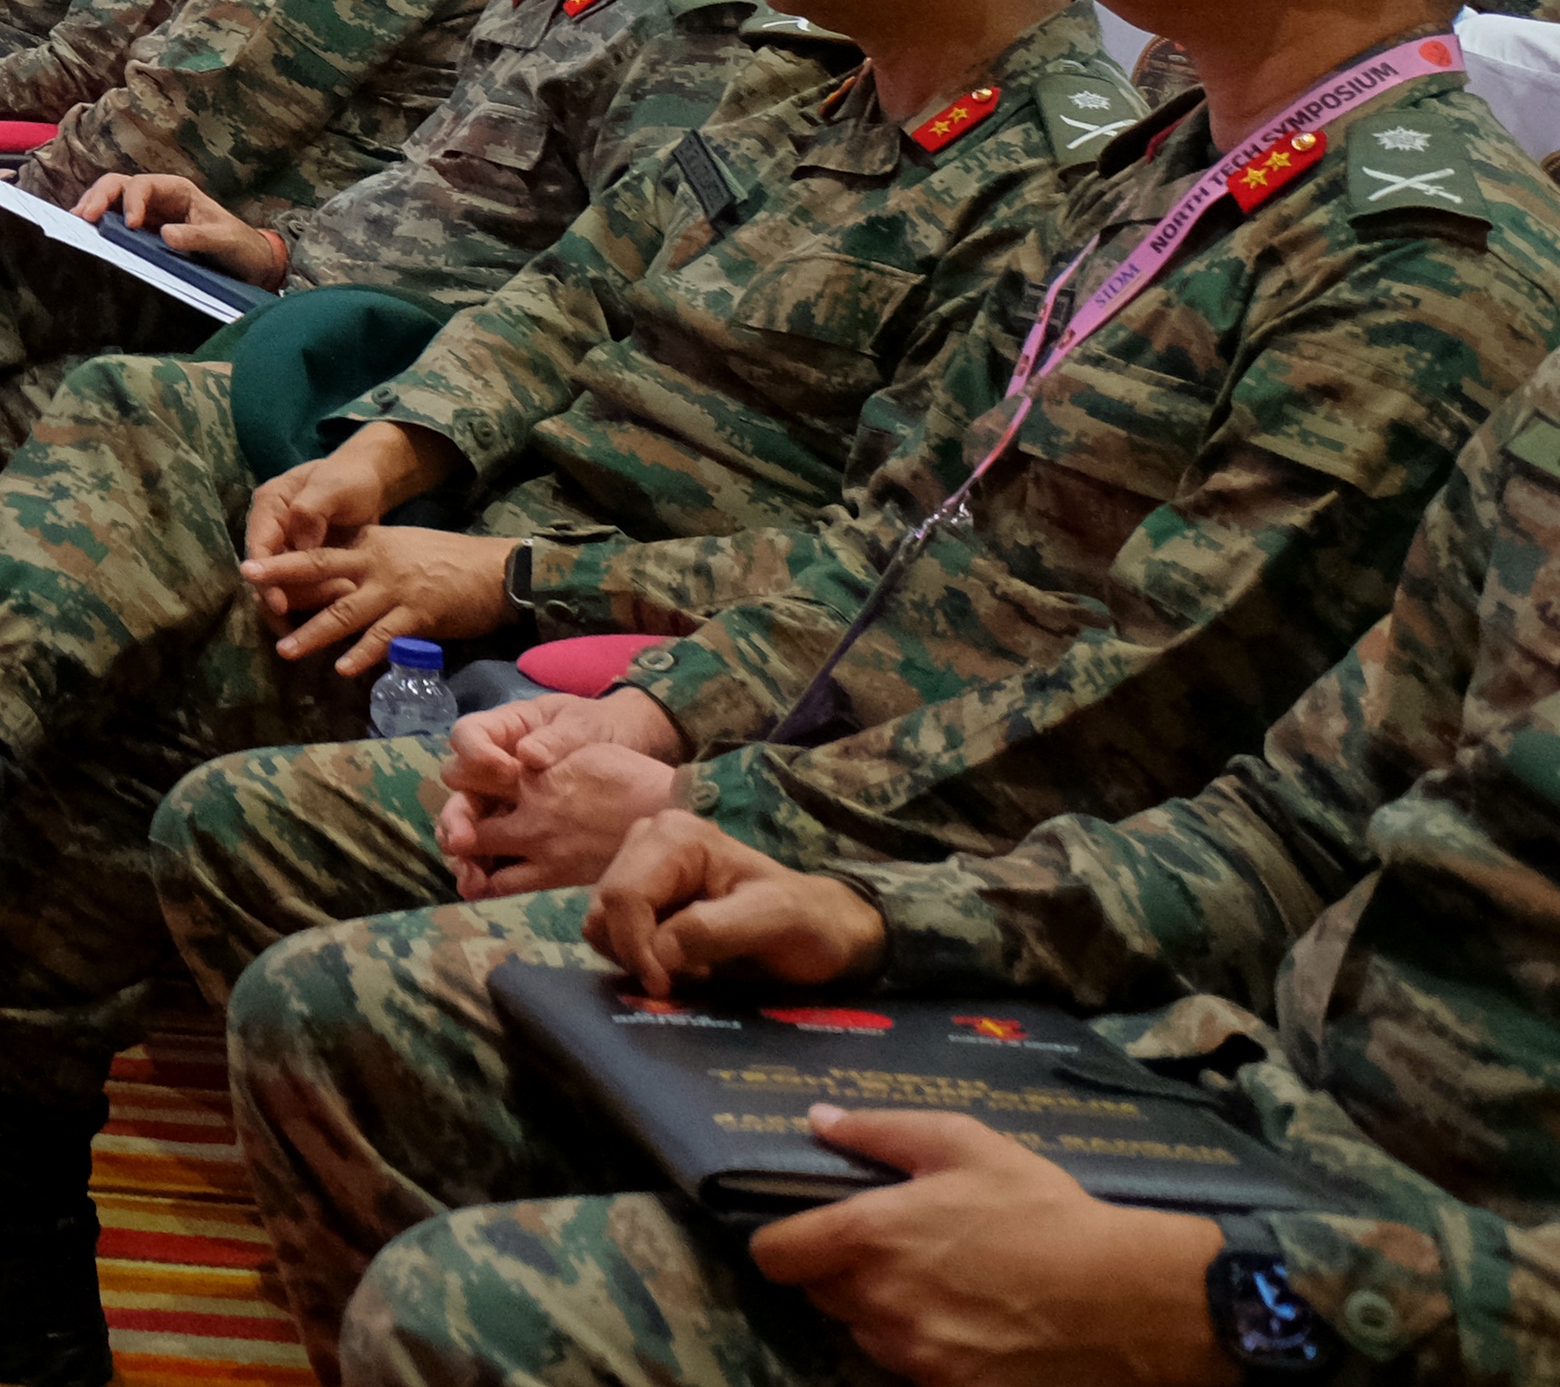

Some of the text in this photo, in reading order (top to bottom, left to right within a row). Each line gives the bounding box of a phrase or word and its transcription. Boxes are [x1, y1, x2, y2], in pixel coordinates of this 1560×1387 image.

[1093, 61, 1400, 309] SIDM NORTH TECH SYMPOSIUM
